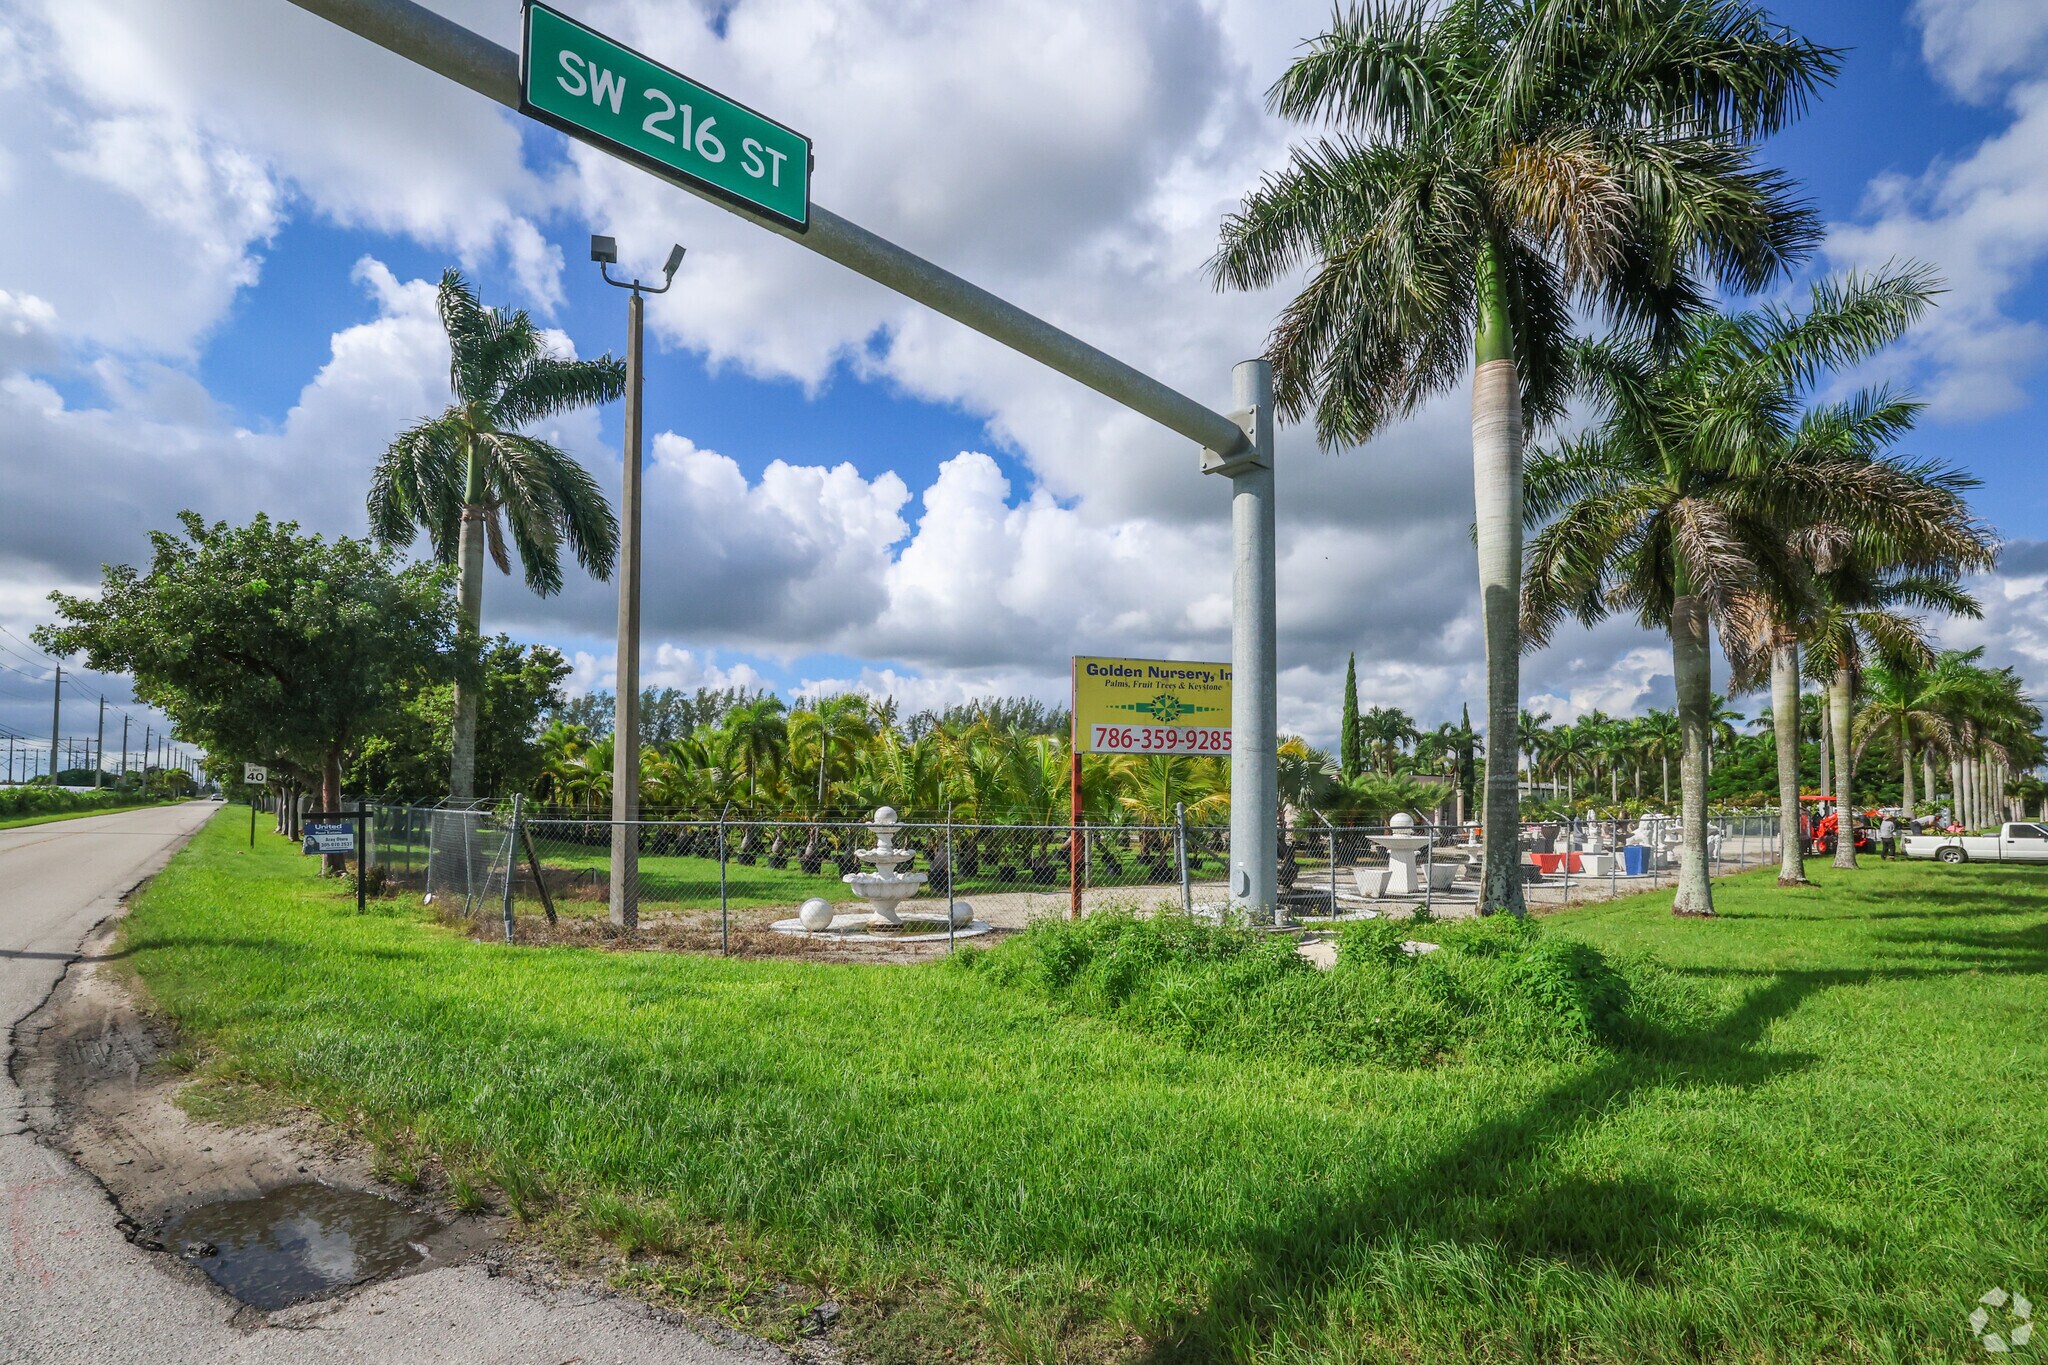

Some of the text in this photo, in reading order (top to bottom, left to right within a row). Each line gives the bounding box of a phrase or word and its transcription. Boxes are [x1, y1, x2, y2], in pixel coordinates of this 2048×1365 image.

[556, 50, 787, 187] SW 216 ST
[1086, 663, 1143, 677] Golden
[1148, 666, 1215, 683] Nursery,
[1156, 681, 1177, 689] Trees
[1178, 682, 1185, 690] &
[1188, 682, 1222, 692] Keystone
[1096, 727, 1232, 750] 786-359-9285
[247, 772, 264, 781] 40
